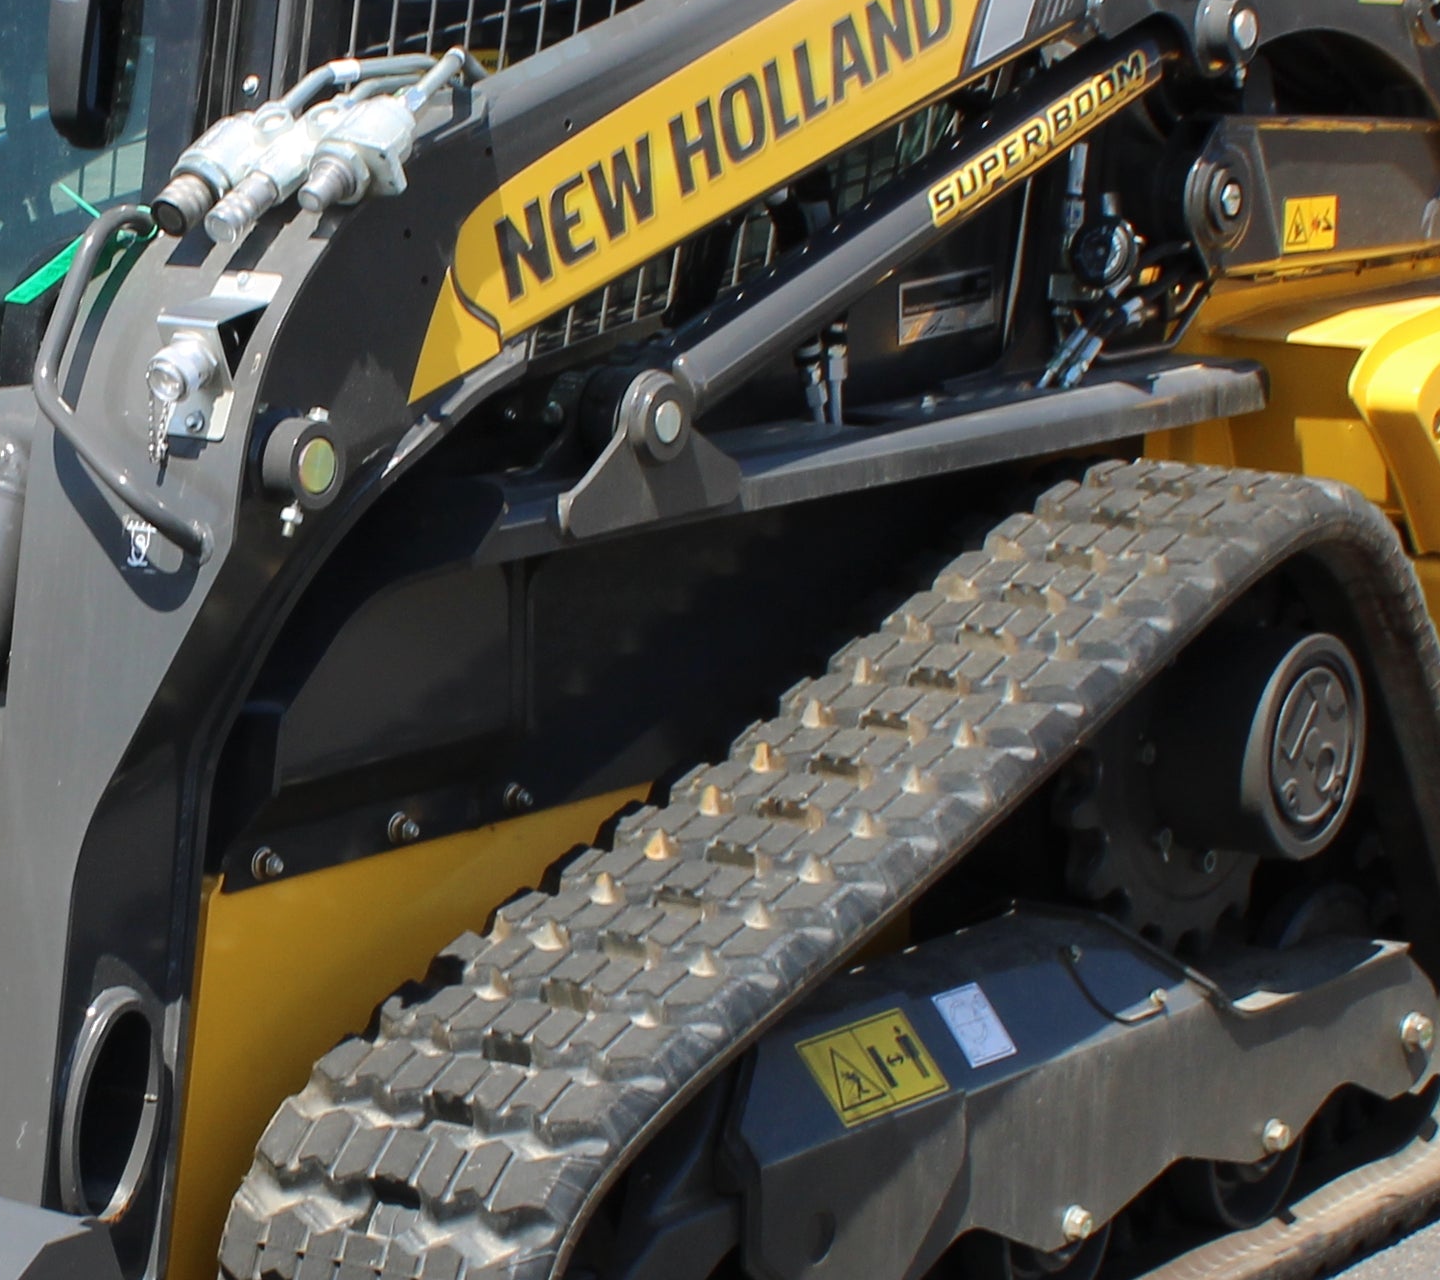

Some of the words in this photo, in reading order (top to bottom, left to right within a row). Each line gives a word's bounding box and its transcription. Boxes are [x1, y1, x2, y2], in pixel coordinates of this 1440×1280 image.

[494, 132, 655, 304] NEW
[929, 117, 1048, 227] SUPER
[1046, 50, 1147, 147] BOOM
